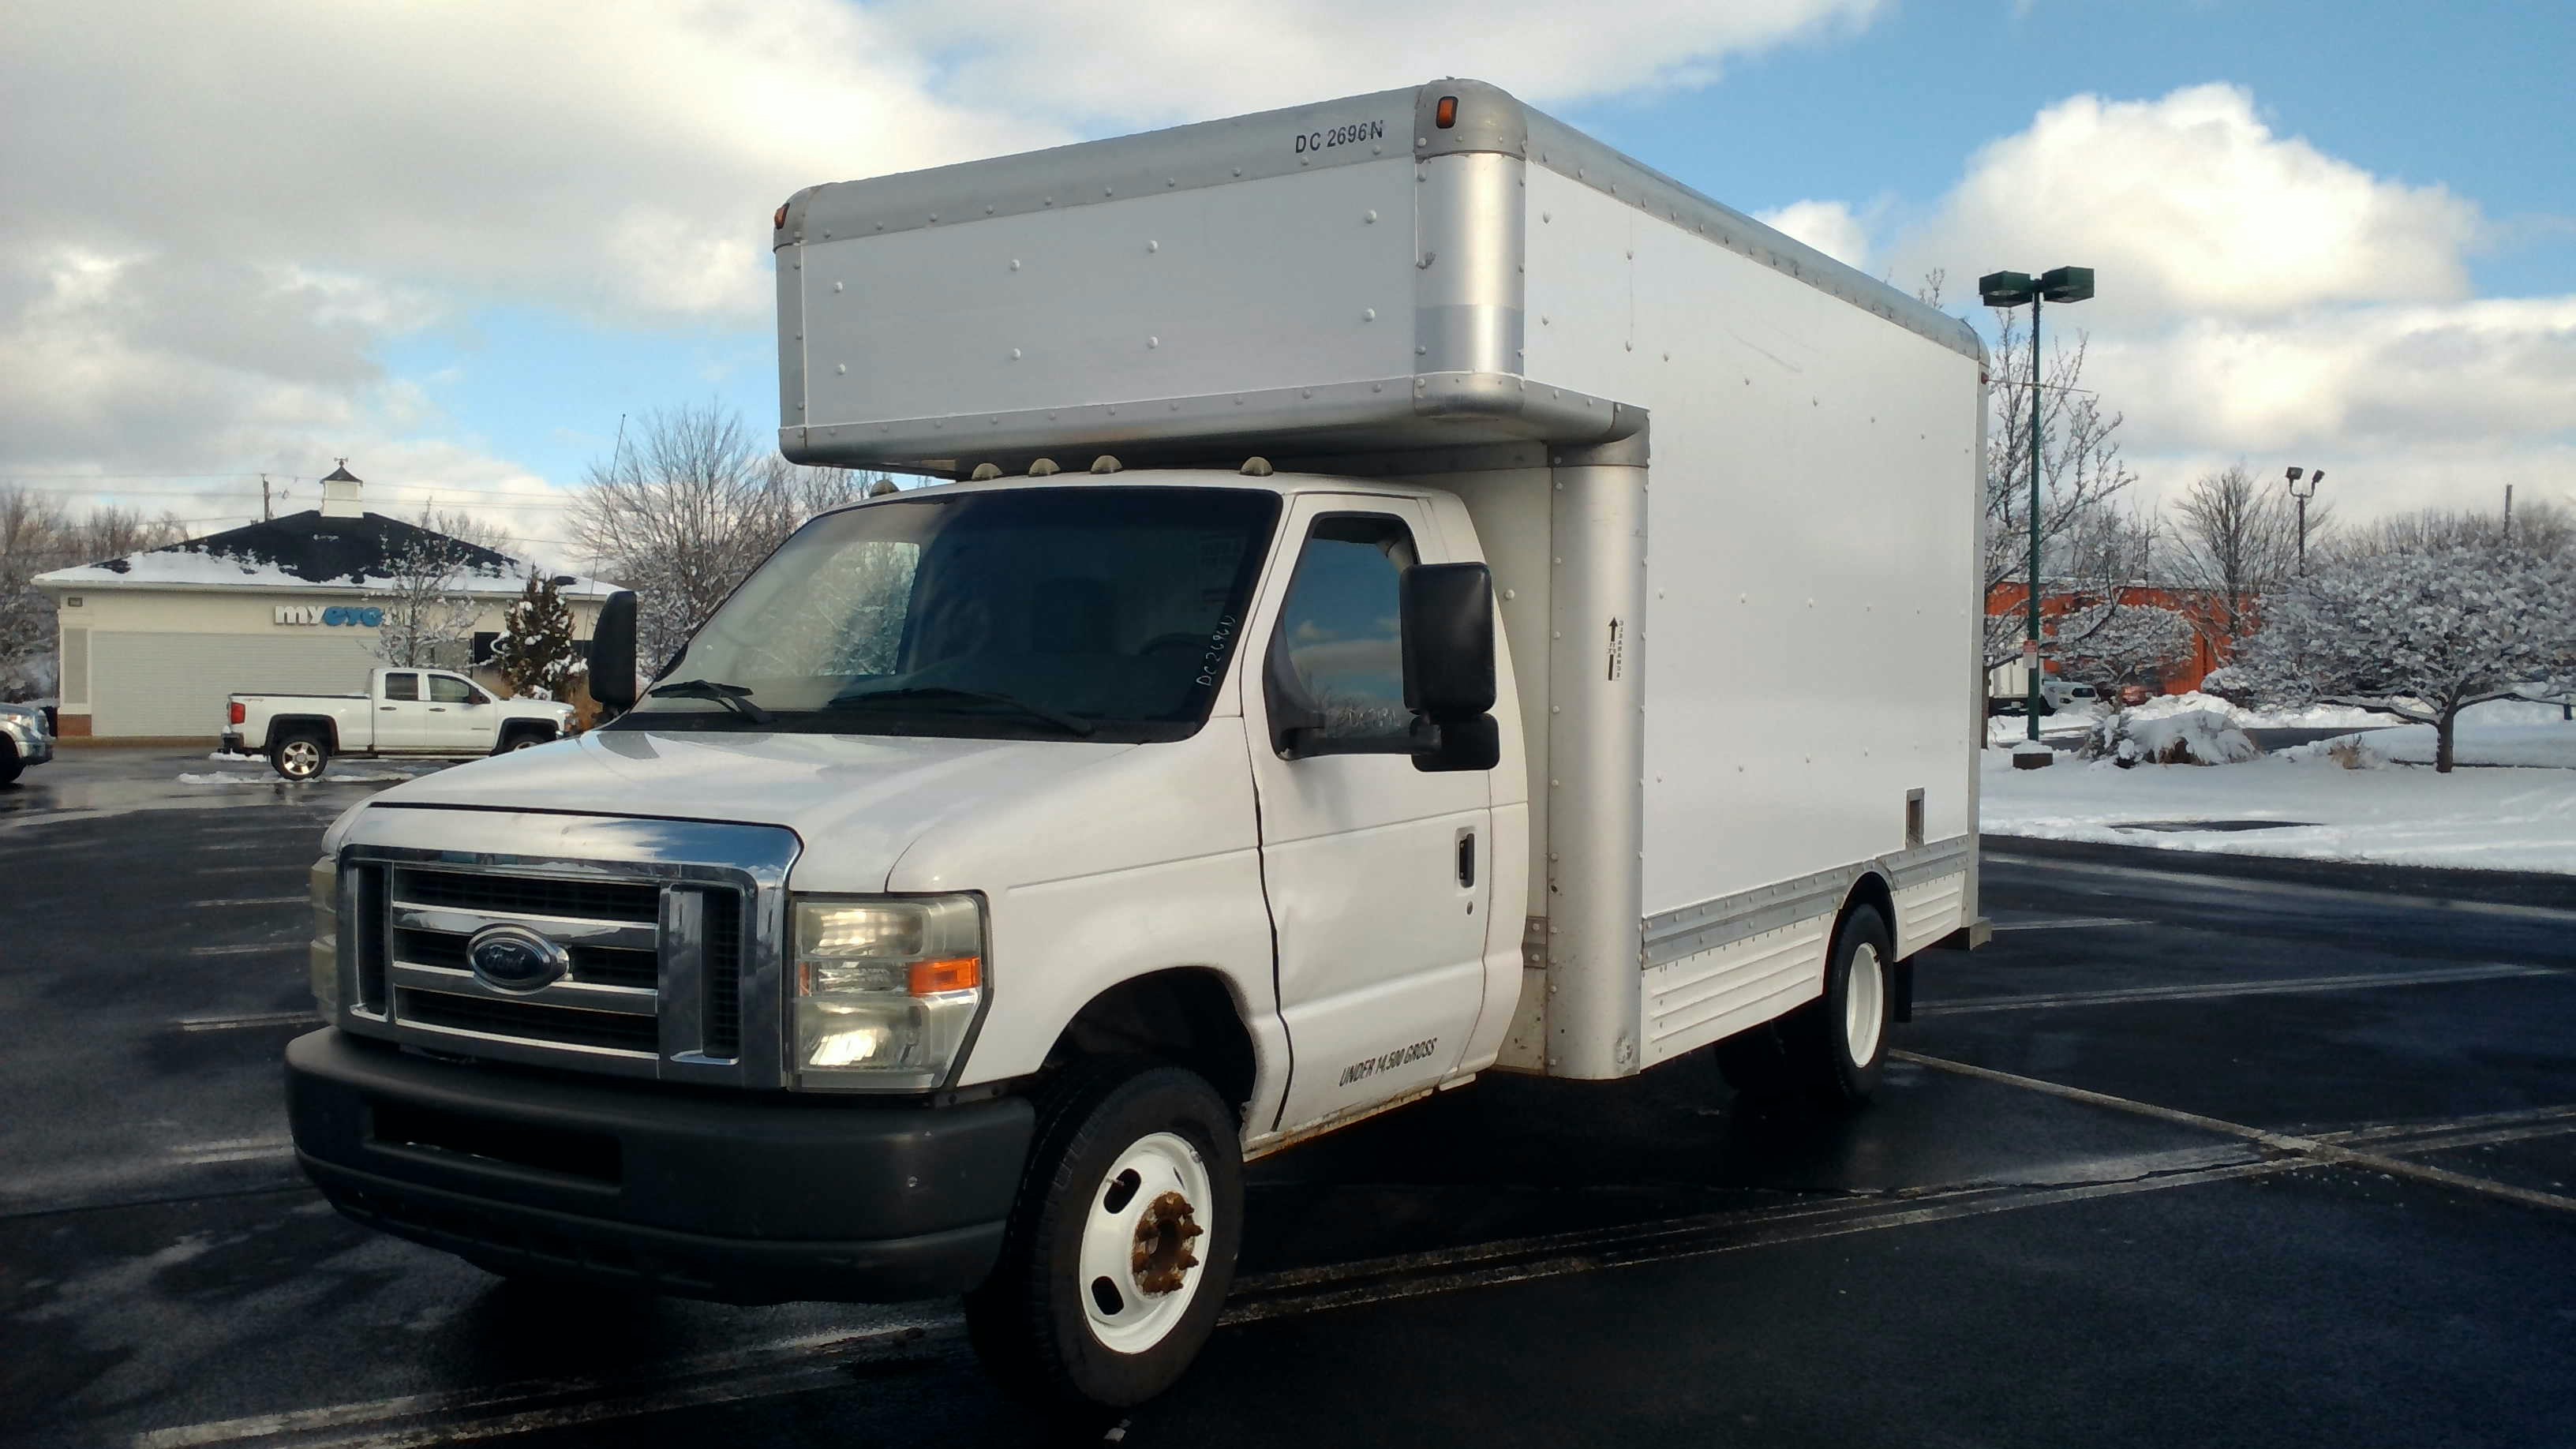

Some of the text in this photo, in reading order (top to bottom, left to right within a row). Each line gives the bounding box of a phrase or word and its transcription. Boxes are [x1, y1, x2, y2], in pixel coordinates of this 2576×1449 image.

[1295, 120, 1383, 153] DC 2696N
[485, 944, 527, 970] Ford
[1339, 1058, 1376, 1087] UNDER
[1403, 1037, 1438, 1065] GROSS
